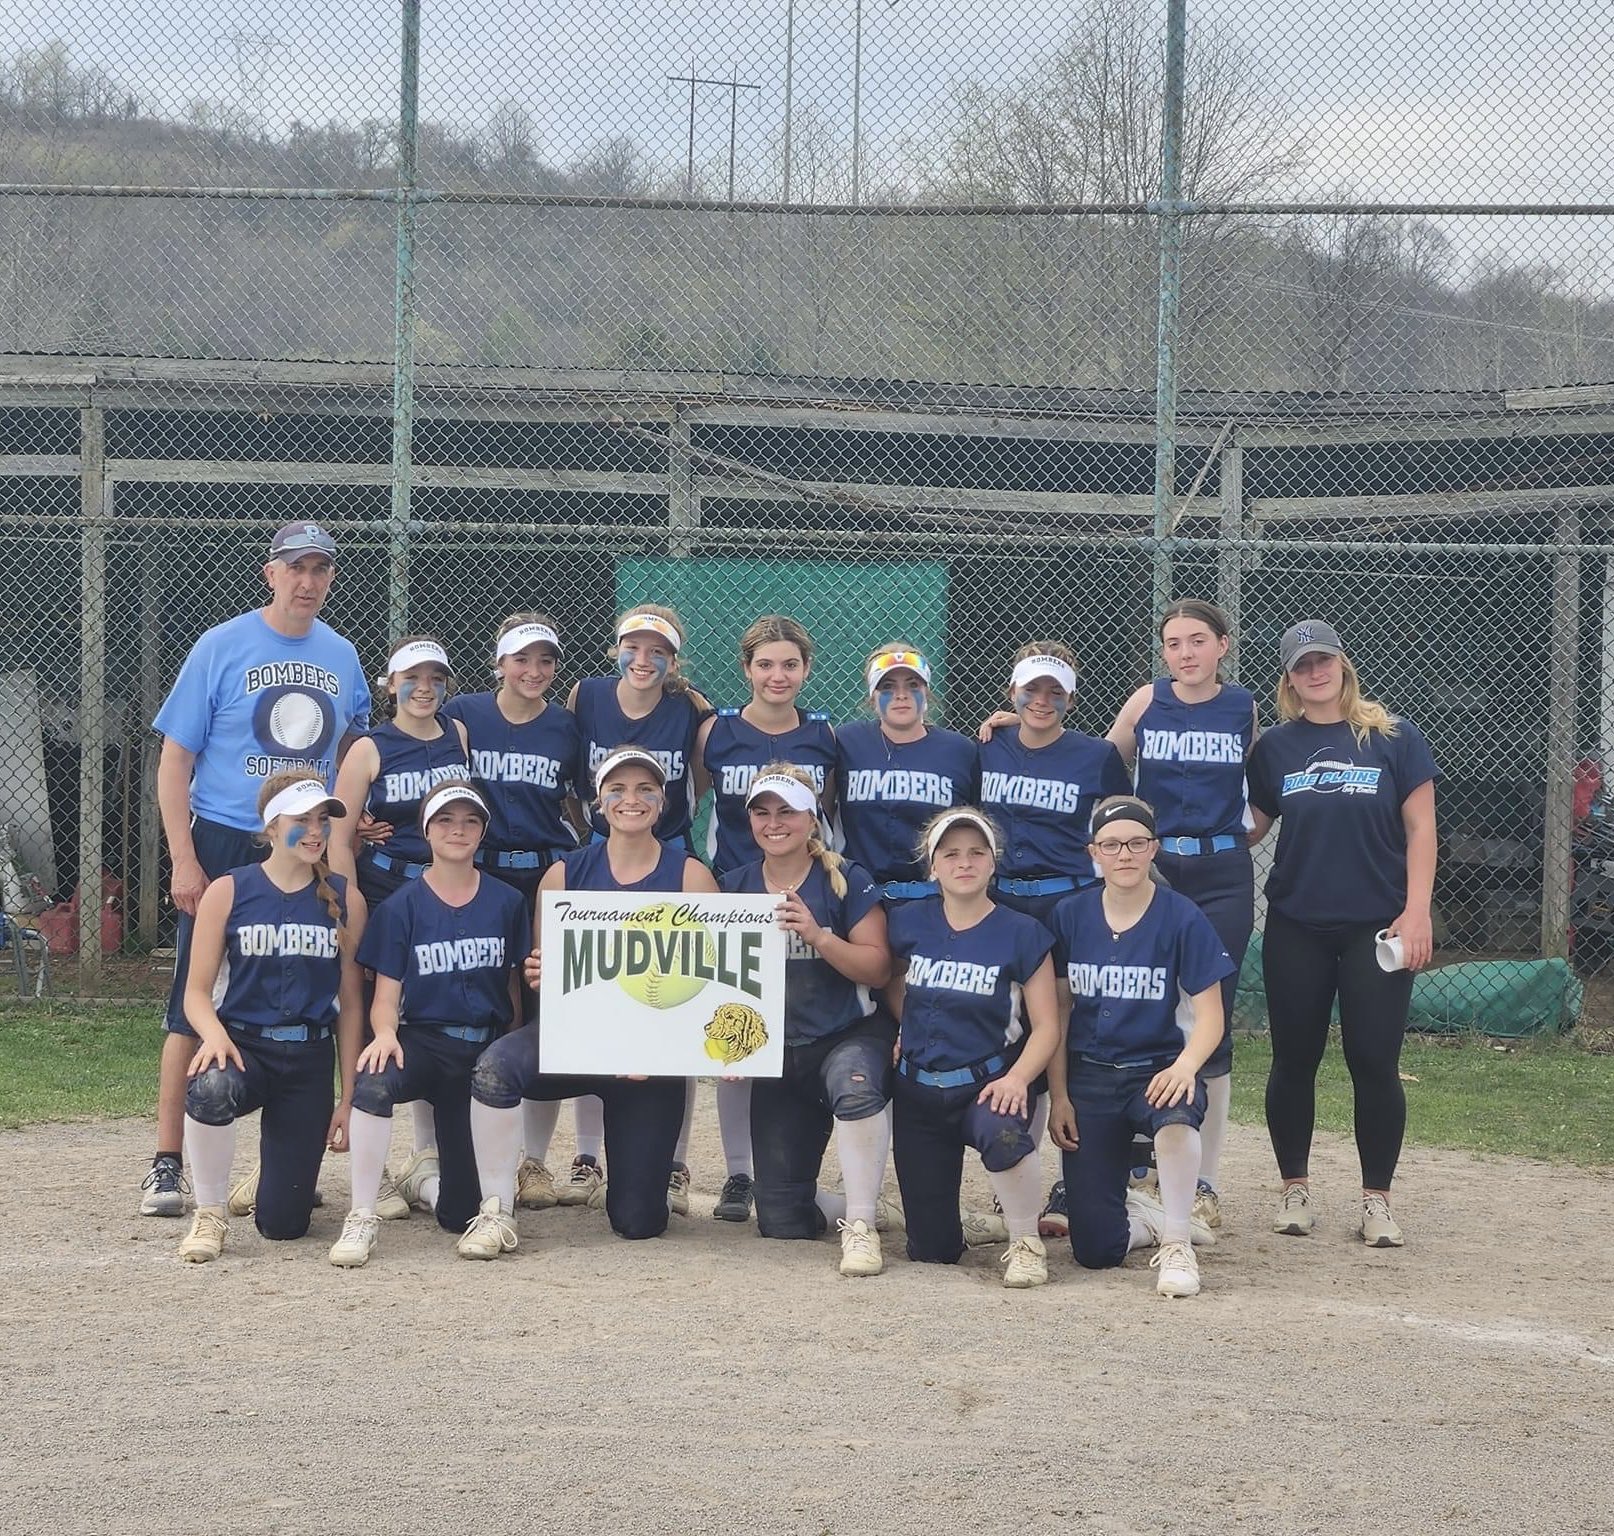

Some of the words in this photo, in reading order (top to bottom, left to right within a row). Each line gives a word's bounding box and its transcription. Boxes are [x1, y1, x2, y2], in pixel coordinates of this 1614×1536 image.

[246, 661, 338, 698] BOMBERS
[1142, 728, 1243, 763] BOMBERS
[847, 770, 954, 807] BOMBERS
[981, 771, 1080, 814] BOMBERS
[1283, 773, 1320, 792] PINE
[1319, 770, 1380, 785] PLAINS
[554, 901, 664, 923] Tournament
[671, 903, 774, 927] Champions
[237, 924, 339, 958] BOMBERS
[562, 929, 763, 1000] MUDVILLE
[905, 954, 1000, 996] OMBERS
[1067, 962, 1166, 1000] BOMBERS
